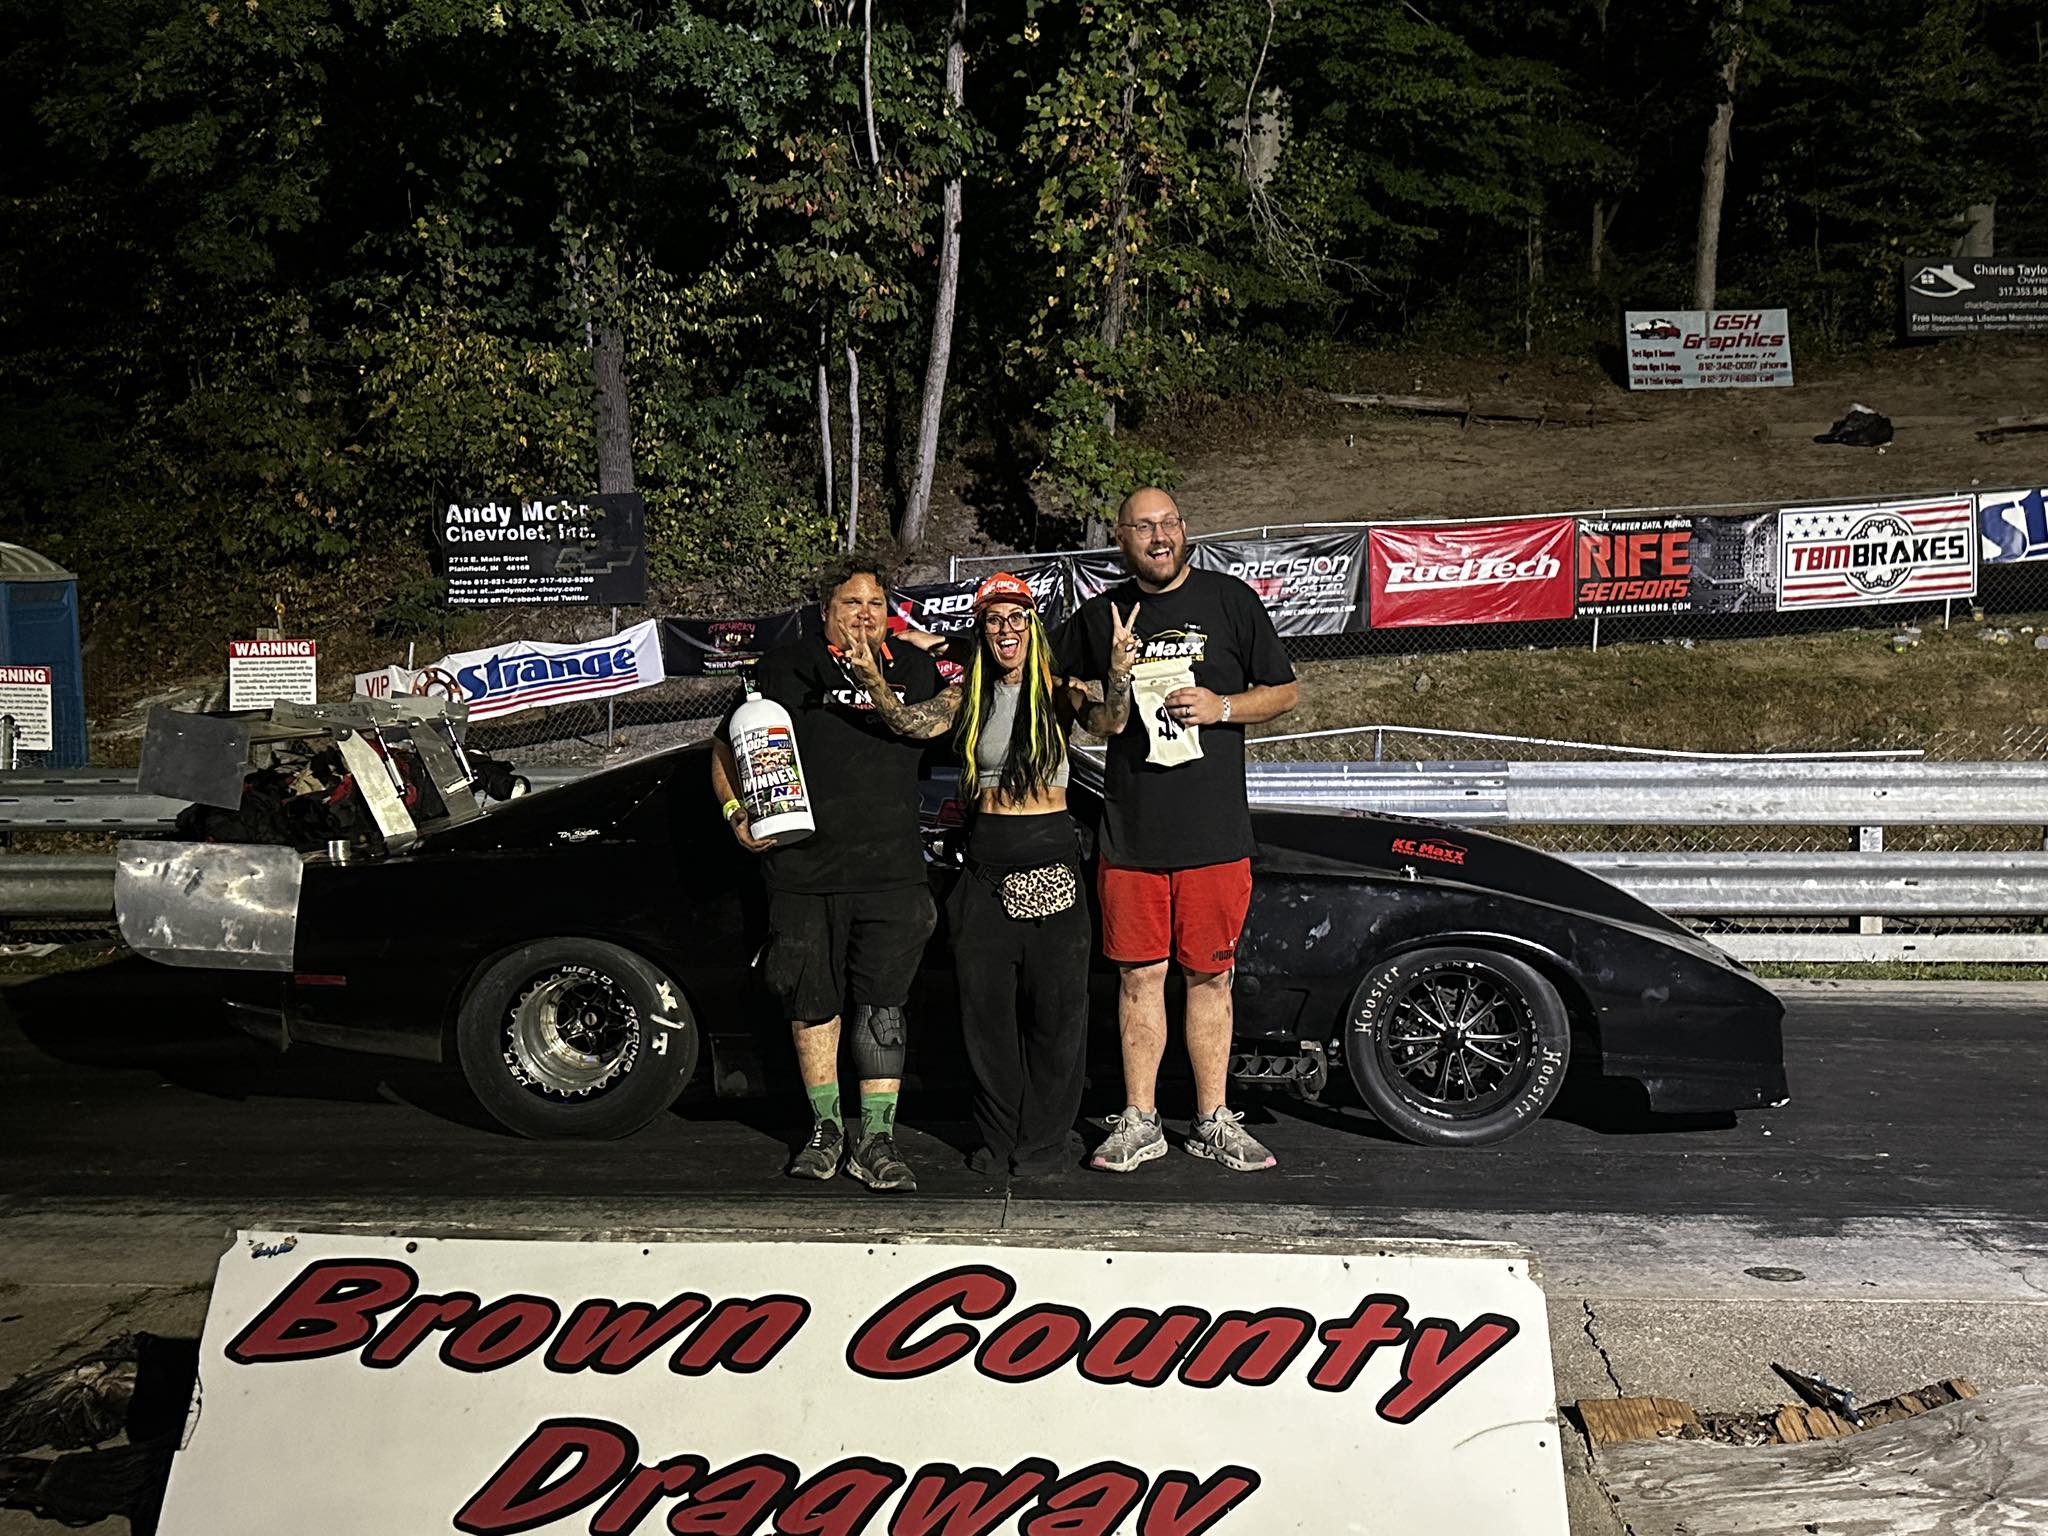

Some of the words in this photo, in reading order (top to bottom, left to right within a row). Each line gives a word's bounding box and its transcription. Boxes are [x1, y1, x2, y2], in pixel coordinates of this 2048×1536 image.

[1973, 264, 2015, 276] Charles
[1713, 314, 1762, 330] GSH
[1683, 333, 1785, 351] Graphics
[1759, 362, 1788, 370] phone
[445, 502, 512, 527] Andy
[446, 525, 551, 543] Chevrolet,
[558, 523, 597, 540] Inc.
[1611, 521, 1641, 531] FASTER
[1579, 532, 1693, 579] RIFE
[1227, 554, 1352, 580] PRECISION
[1386, 554, 1561, 584] FuelTech
[1579, 580, 1691, 602] SENSORS
[234, 641, 311, 656] WARNING
[1145, 640, 1205, 657] Maxx
[456, 648, 636, 701] Strange
[365, 675, 389, 698] VIP
[735, 737, 769, 759] WODS
[742, 767, 798, 794] WINNER
[773, 786, 800, 797] NX
[1418, 843, 1464, 860] Maxx
[561, 965, 614, 985] WELD
[1354, 965, 1400, 1037] Hoosier
[224, 1257, 812, 1377] Brown
[845, 1264, 1519, 1425] County
[453, 1417, 1261, 1536] Dragway
